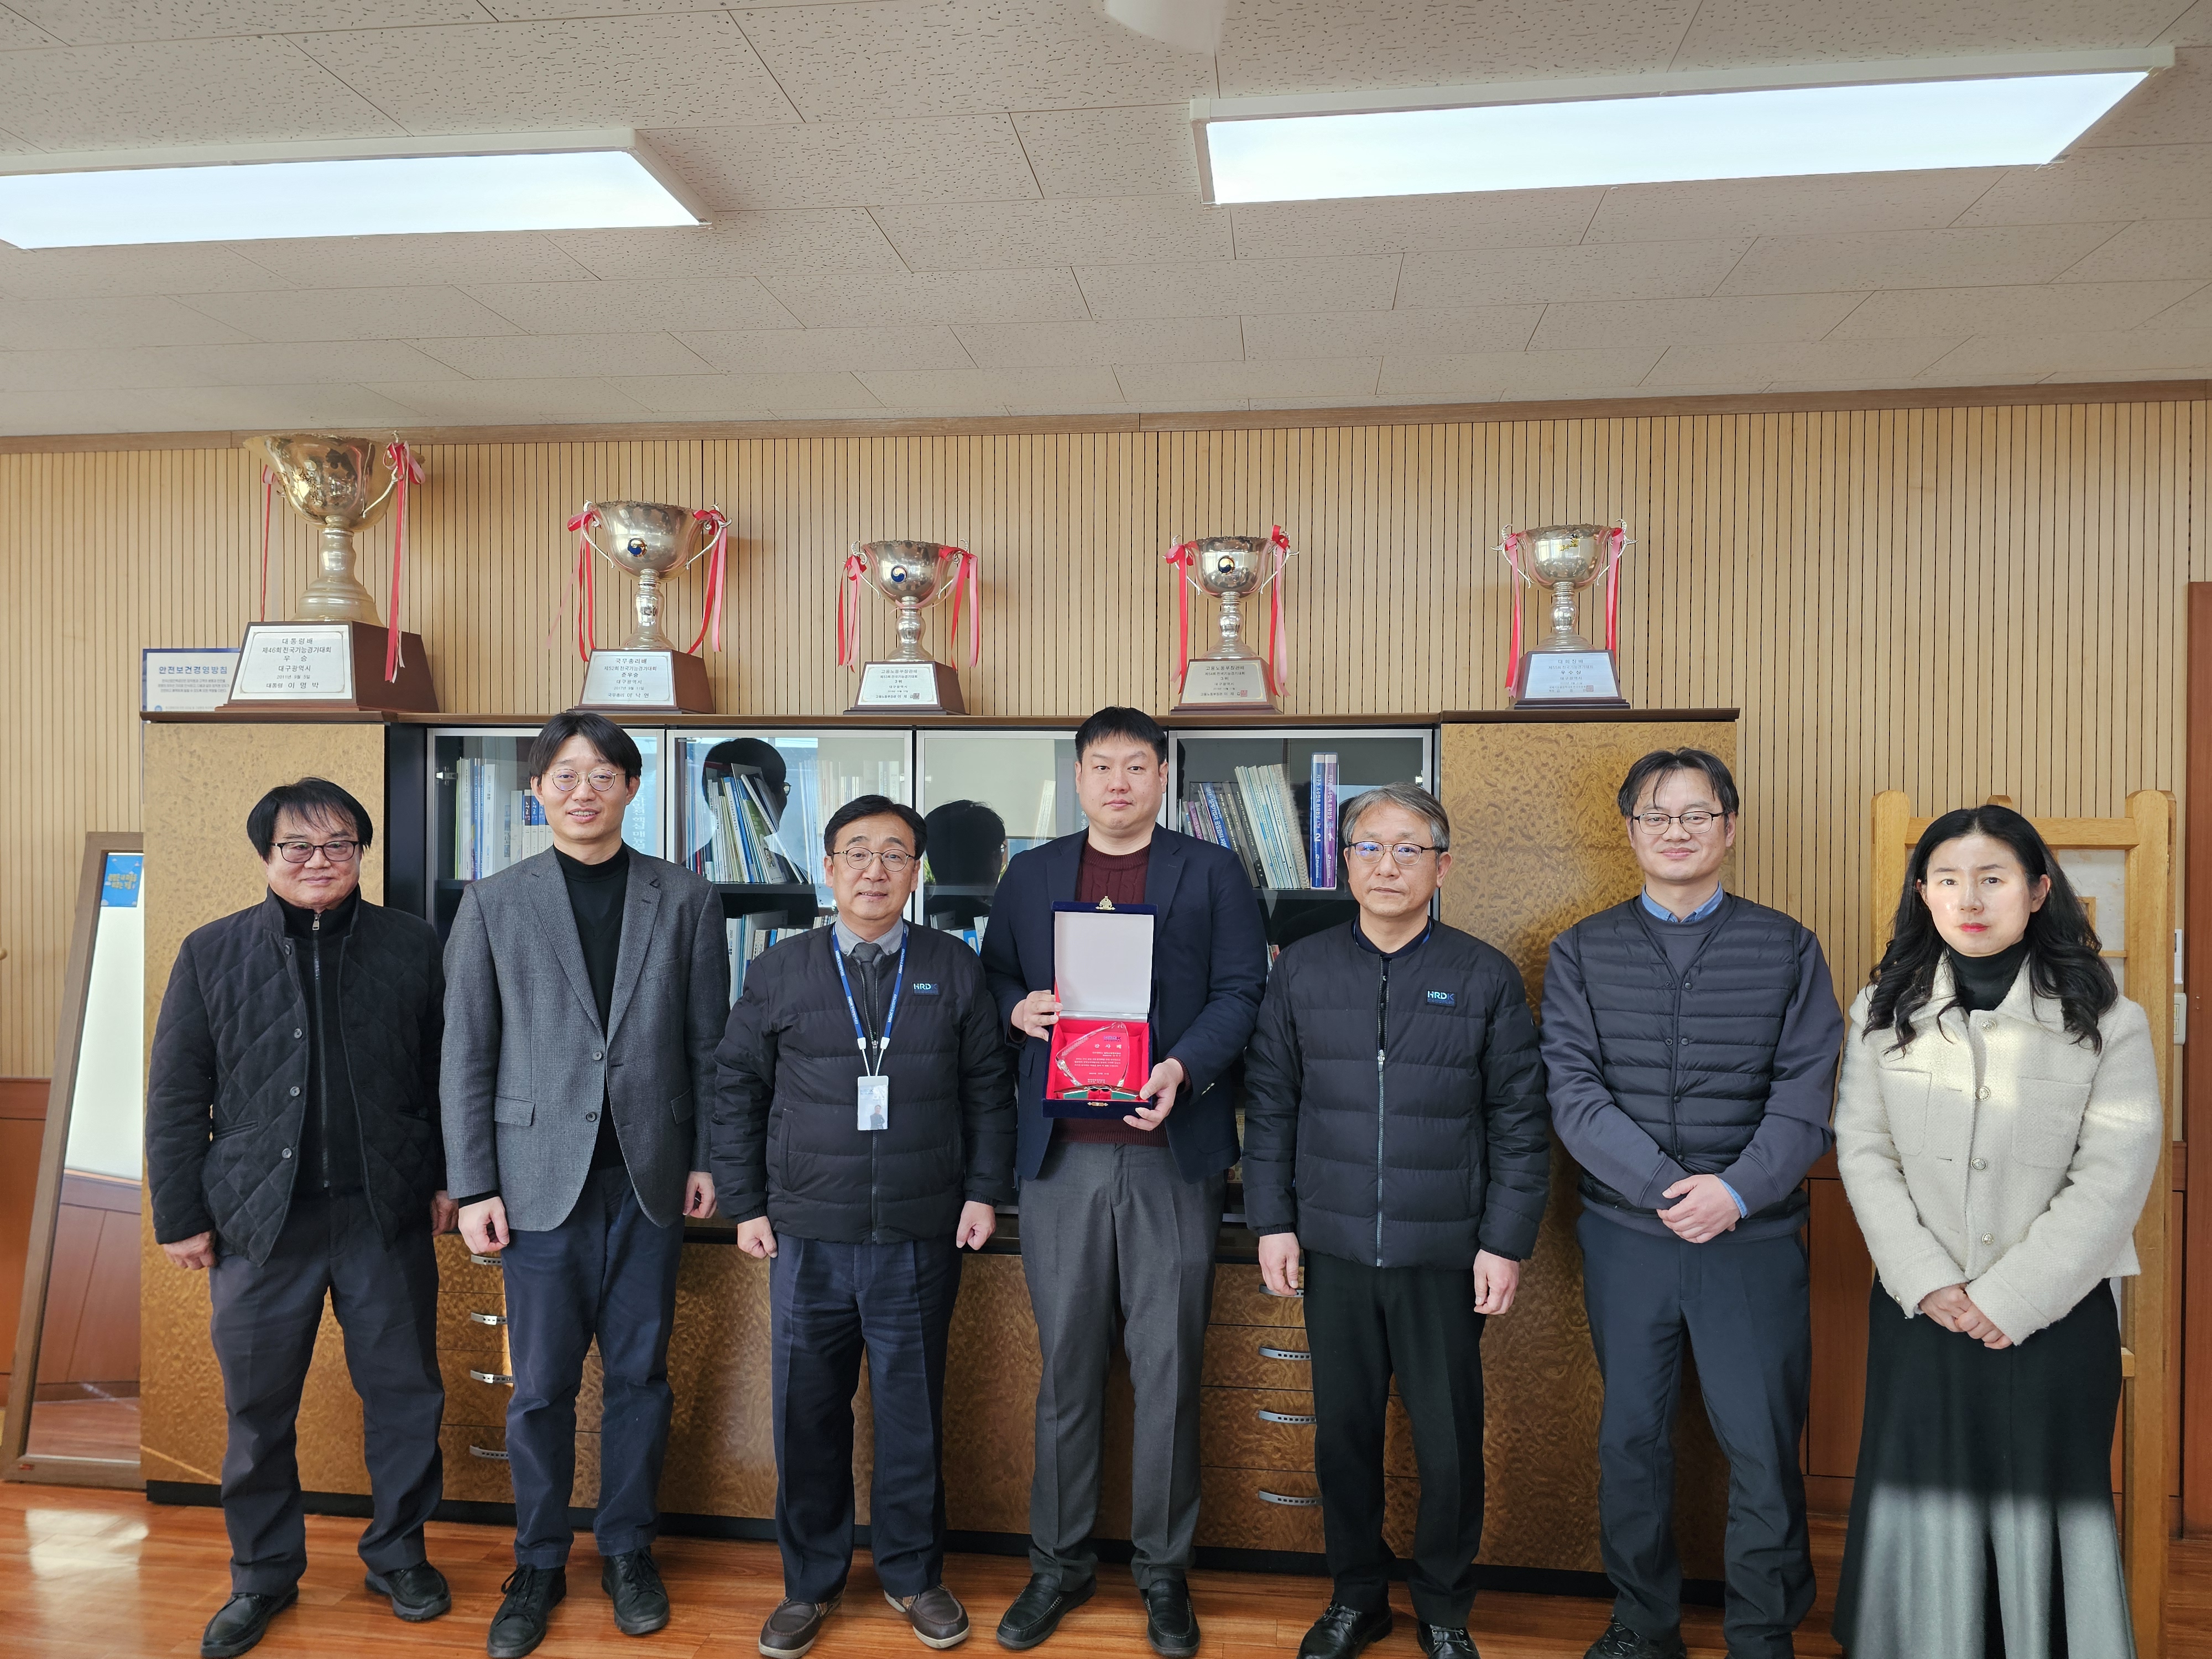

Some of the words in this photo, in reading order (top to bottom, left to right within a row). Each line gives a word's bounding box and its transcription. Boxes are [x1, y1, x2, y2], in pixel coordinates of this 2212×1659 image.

[159, 666, 227, 674] 안전보건경영방침
[632, 817, 645, 830] 핵심
[632, 831, 646, 849] 매뉴얼
[1314, 833, 1321, 842] 2
[1427, 990, 1454, 1000] HRDK
